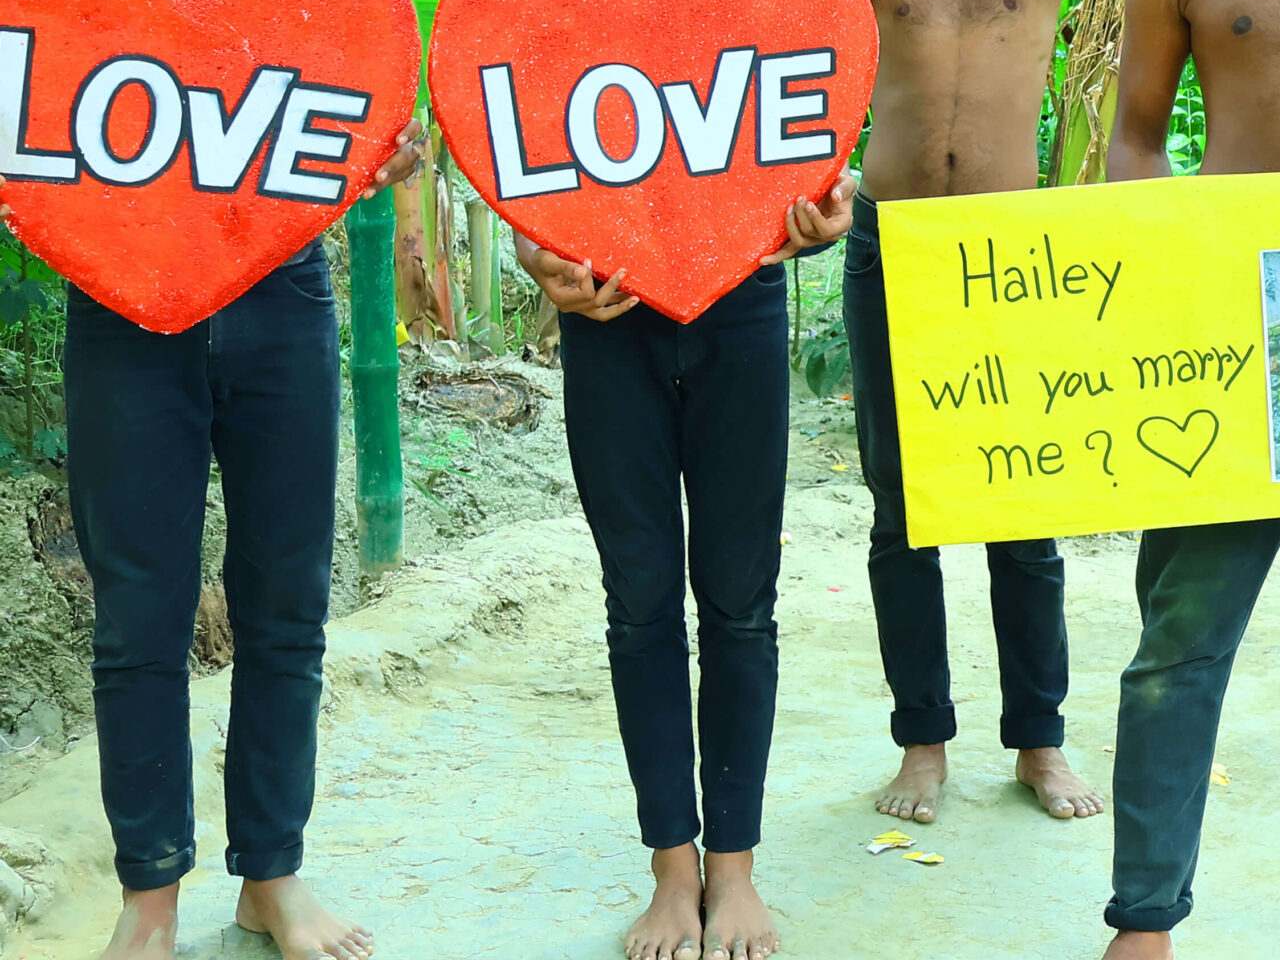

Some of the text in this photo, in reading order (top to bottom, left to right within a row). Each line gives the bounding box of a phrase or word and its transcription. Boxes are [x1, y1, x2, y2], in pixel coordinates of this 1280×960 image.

[0, 26, 372, 203] LOVE
[479, 46, 837, 200] LOVE
[959, 234, 1121, 320] Hailey
[921, 344, 1254, 414] will you marry
